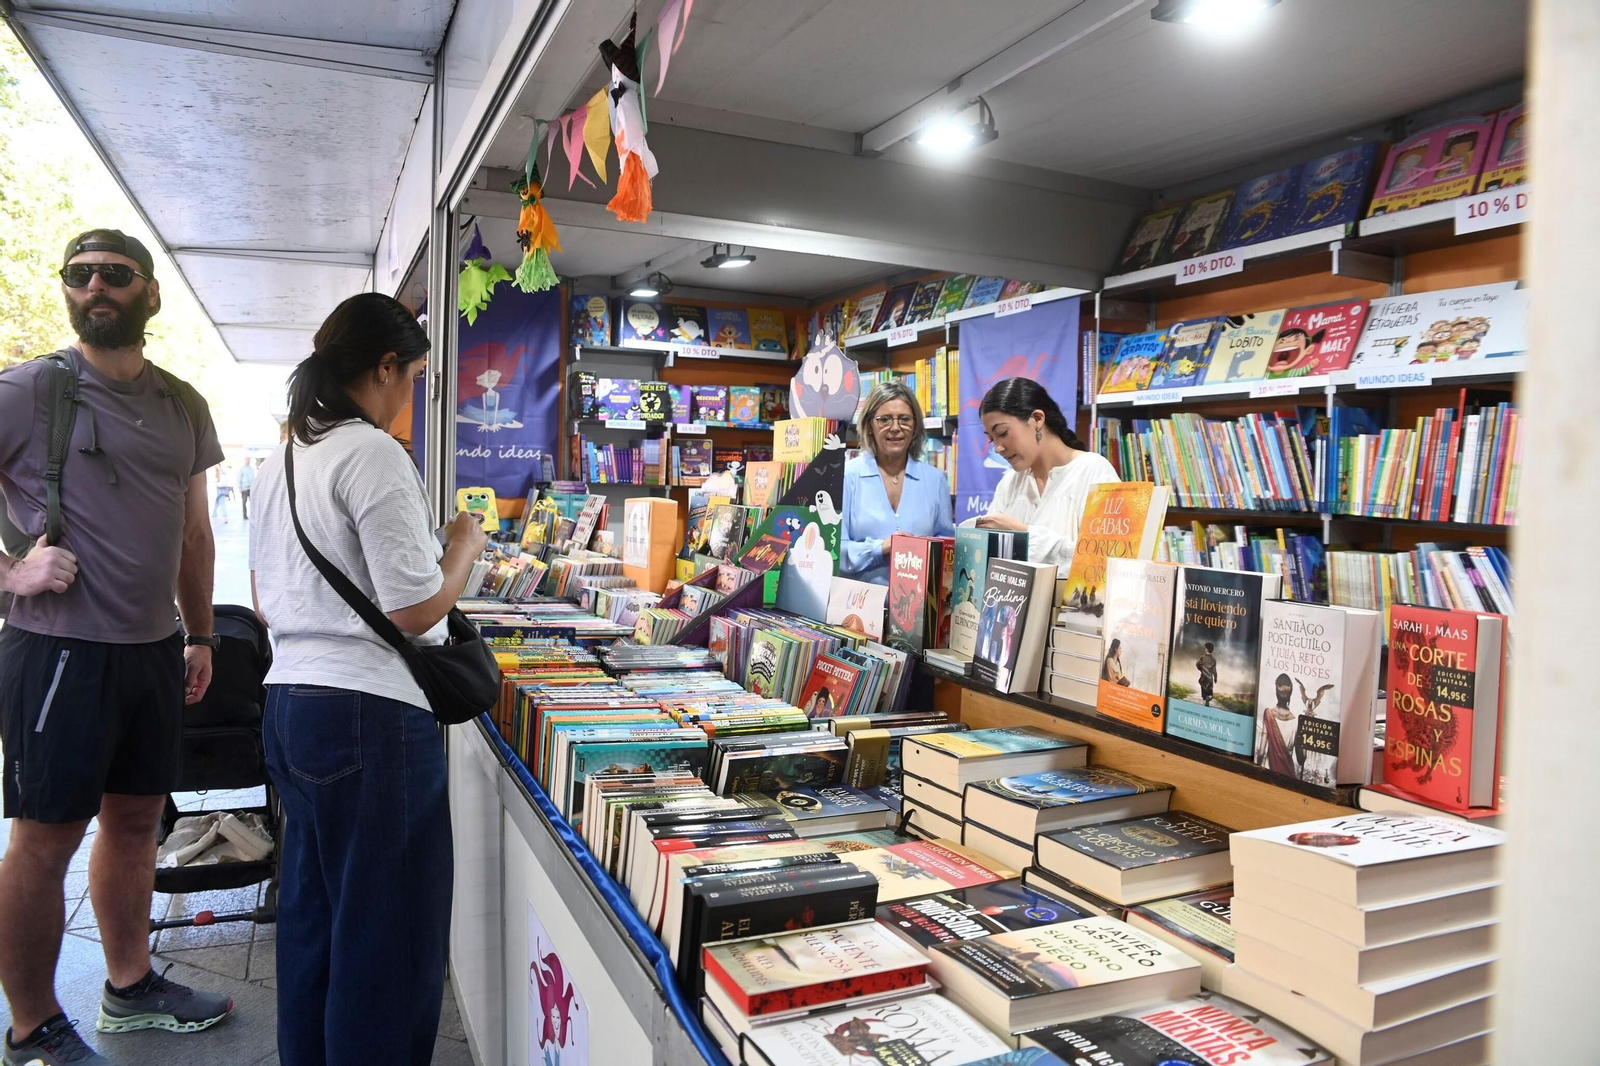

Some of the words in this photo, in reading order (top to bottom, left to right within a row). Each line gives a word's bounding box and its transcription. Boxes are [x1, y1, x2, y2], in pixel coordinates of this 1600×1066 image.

[1467, 201, 1489, 219] 10
[1494, 196, 1510, 214] %
[1182, 264, 1196, 277] 10
[1197, 261, 1208, 273] %
[1210, 255, 1236, 271] DTO.
[998, 304, 1006, 313] 10
[1014, 298, 1031, 310] DTO.
[1438, 298, 1448, 308] Tu
[1450, 297, 1472, 307] cuerpo
[1120, 343, 1160, 357] CERDITOS
[1229, 336, 1264, 349] LOBITO
[1319, 336, 1352, 354] MAL?
[682, 347, 691, 355] 10
[701, 349, 719, 357] DTO.
[1359, 374, 1397, 385] MUNDO
[1399, 372, 1426, 383] IDEAS
[1161, 392, 1179, 400] IDEAS
[1258, 386, 1268, 395] 10
[640, 412, 664, 420] UIDADO!
[456, 445, 492, 459] ndo
[498, 445, 541, 460] ideas
[716, 454, 743, 462] esqueleto
[1103, 497, 1124, 514] LUZ
[990, 571, 1007, 584] CHLOE
[1007, 575, 1027, 588] WALSH
[982, 586, 1027, 617] Binding
[1213, 587, 1245, 598] MERCERO
[1201, 599, 1247, 617] lloviendo
[1185, 613, 1192, 624] y
[1194, 614, 1203, 623] te
[1204, 615, 1237, 630] quiero
[1273, 618, 1325, 637] SANTIAGO
[1393, 618, 1422, 634] SARAH
[1425, 624, 1431, 636] J.
[1435, 625, 1468, 641] MAAS
[1268, 631, 1331, 652] POSTEGUILLO
[1270, 646, 1276, 656] Y
[1276, 647, 1297, 663] JULIA
[1299, 651, 1325, 666] RETÓ
[1392, 640, 1407, 652] UNA
[1409, 644, 1468, 671] CORTE
[815, 660, 834, 674] POCKET
[832, 664, 855, 683] POTTERS
[1265, 658, 1271, 667] A
[1273, 659, 1289, 671] LOS
[1292, 663, 1331, 680] DIOSES
[1437, 670, 1467, 681] EDICIÓN
[1407, 672, 1423, 688] DE
[1435, 677, 1468, 687] LIMITADA
[1436, 685, 1467, 702] 14,95€
[1392, 690, 1452, 723] ROSAS
[1178, 714, 1208, 730] CARMEN
[1301, 725, 1333, 737] LIMITADA
[1304, 720, 1332, 730] EDICIÓN
[1302, 733, 1332, 750] 14,95€
[1433, 728, 1443, 743] Y
[1387, 736, 1462, 777] ESPINAS
[1143, 816, 1223, 845] FOLLETT
[1179, 820, 1216, 837] KEN
[1080, 826, 1098, 836] EL
[1097, 832, 1157, 858] CÍRCULO
[1080, 832, 1107, 848] LOS
[1105, 844, 1142, 859] DÍAS
[793, 853, 828, 861] FOLLETT
[920, 841, 954, 859] MISIÓN
[953, 855, 969, 866] EN
[965, 863, 996, 880] PARÍS
[929, 860, 967, 880] ALATRISTE
[740, 886, 782, 898] CAPITÁN
[782, 885, 794, 893] EL
[737, 918, 750, 936] EL
[905, 899, 991, 940] PROFESORA
[821, 928, 883, 970] PACIENTE
[863, 940, 880, 950] LA
[1044, 929, 1123, 972] SUSURRO
[1073, 924, 1155, 968] CASTILLO
[1099, 926, 1164, 957] JAVIER
[754, 955, 775, 970] ALEX
[799, 932, 853, 975] SILENCIOSA
[1025, 937, 1088, 970] FUEGO
[726, 945, 772, 986] MICHAELIDES
[909, 1006, 950, 1038] HISTORIA
[949, 1036, 965, 1045] DE
[940, 1008, 966, 1029] Eslava
[775, 1026, 796, 1042] PARA
[867, 1003, 955, 1065] ROMA
[1183, 1005, 1278, 1051] NUNCA
[1052, 1029, 1098, 1055] FREIDA
[1140, 1010, 1252, 1066] MIENTAS
